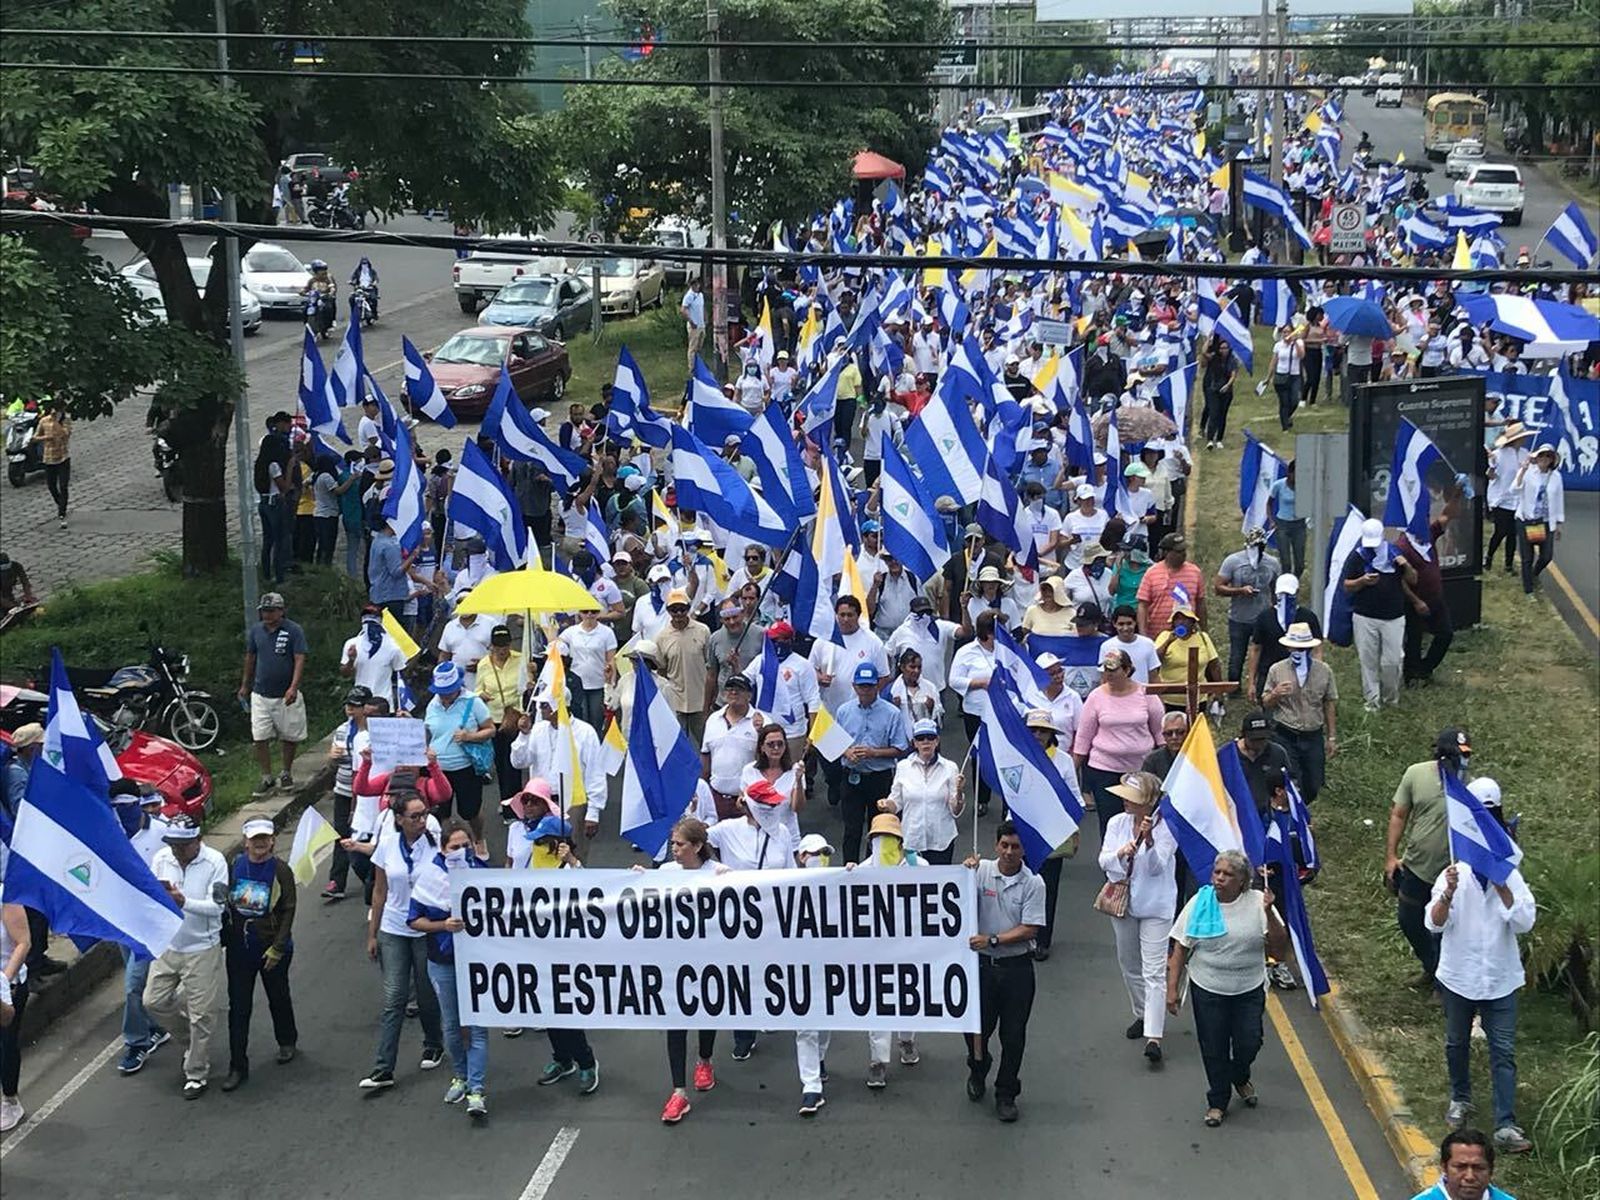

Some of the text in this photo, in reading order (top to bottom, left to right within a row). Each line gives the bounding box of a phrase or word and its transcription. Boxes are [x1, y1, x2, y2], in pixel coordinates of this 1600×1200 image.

[461, 882, 962, 940] GRACIAS OBISPOS VALIENTES
[469, 962, 968, 1018] POR ESTAR CON SU PUEBLO
